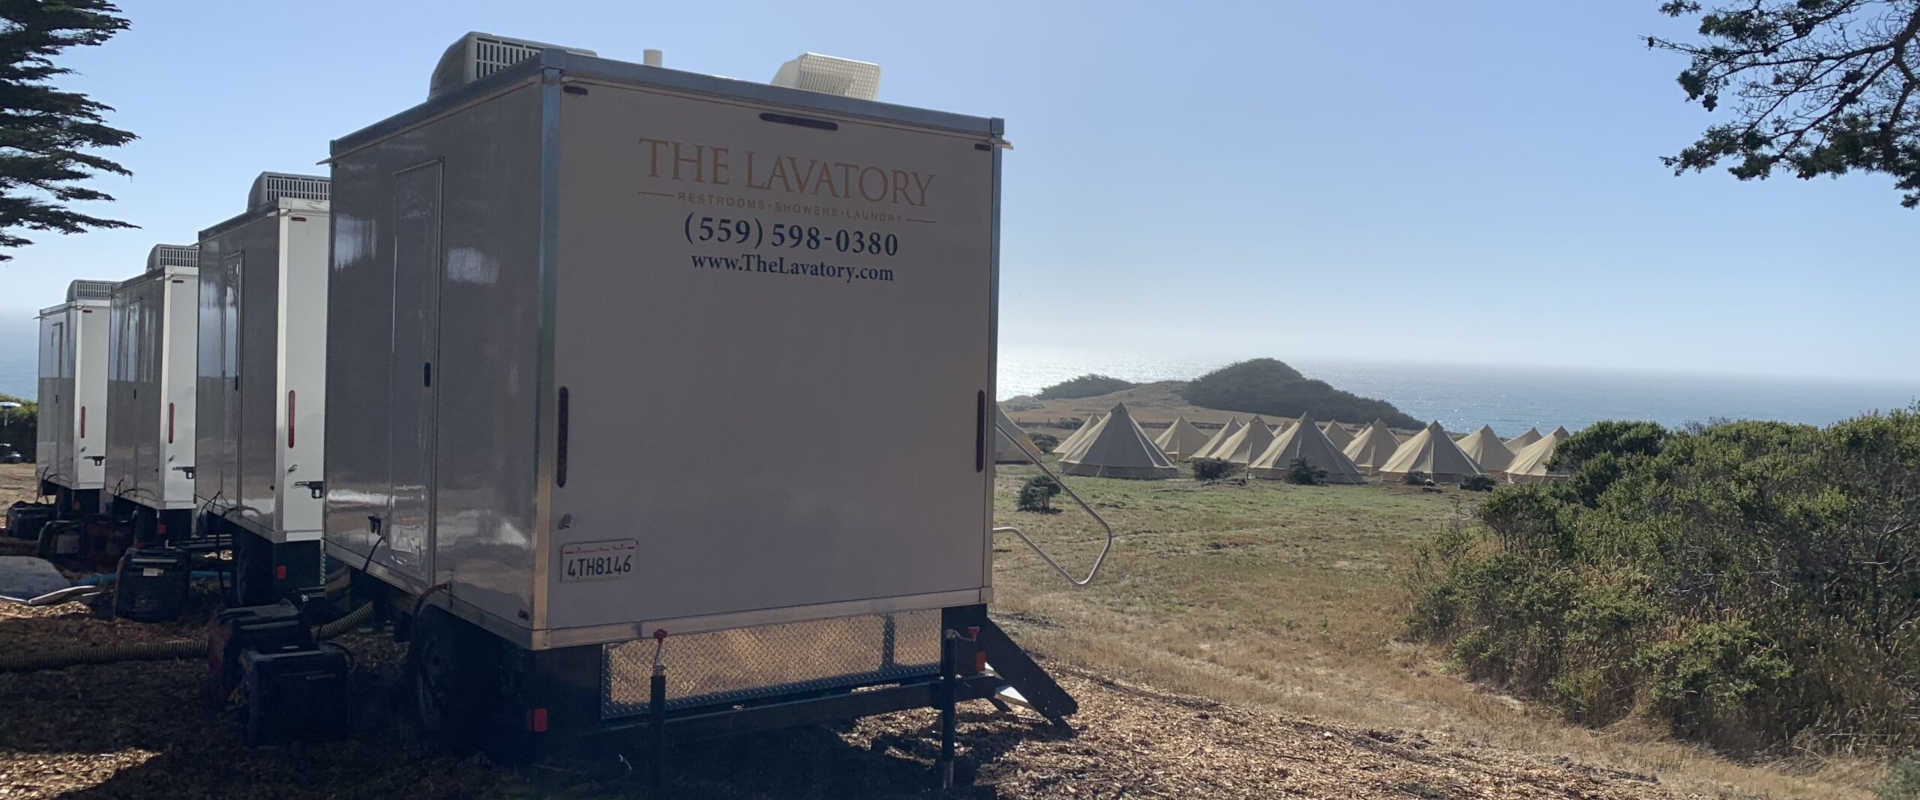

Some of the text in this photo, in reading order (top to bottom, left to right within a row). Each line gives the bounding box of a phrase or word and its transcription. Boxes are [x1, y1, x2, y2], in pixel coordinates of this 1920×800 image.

[638, 138, 937, 208] THE LAVATORY
[683, 211, 899, 257] (559) 598-0380
[691, 253, 895, 283] www.TheLavatory.com
[567, 554, 633, 577] 4TH8146
